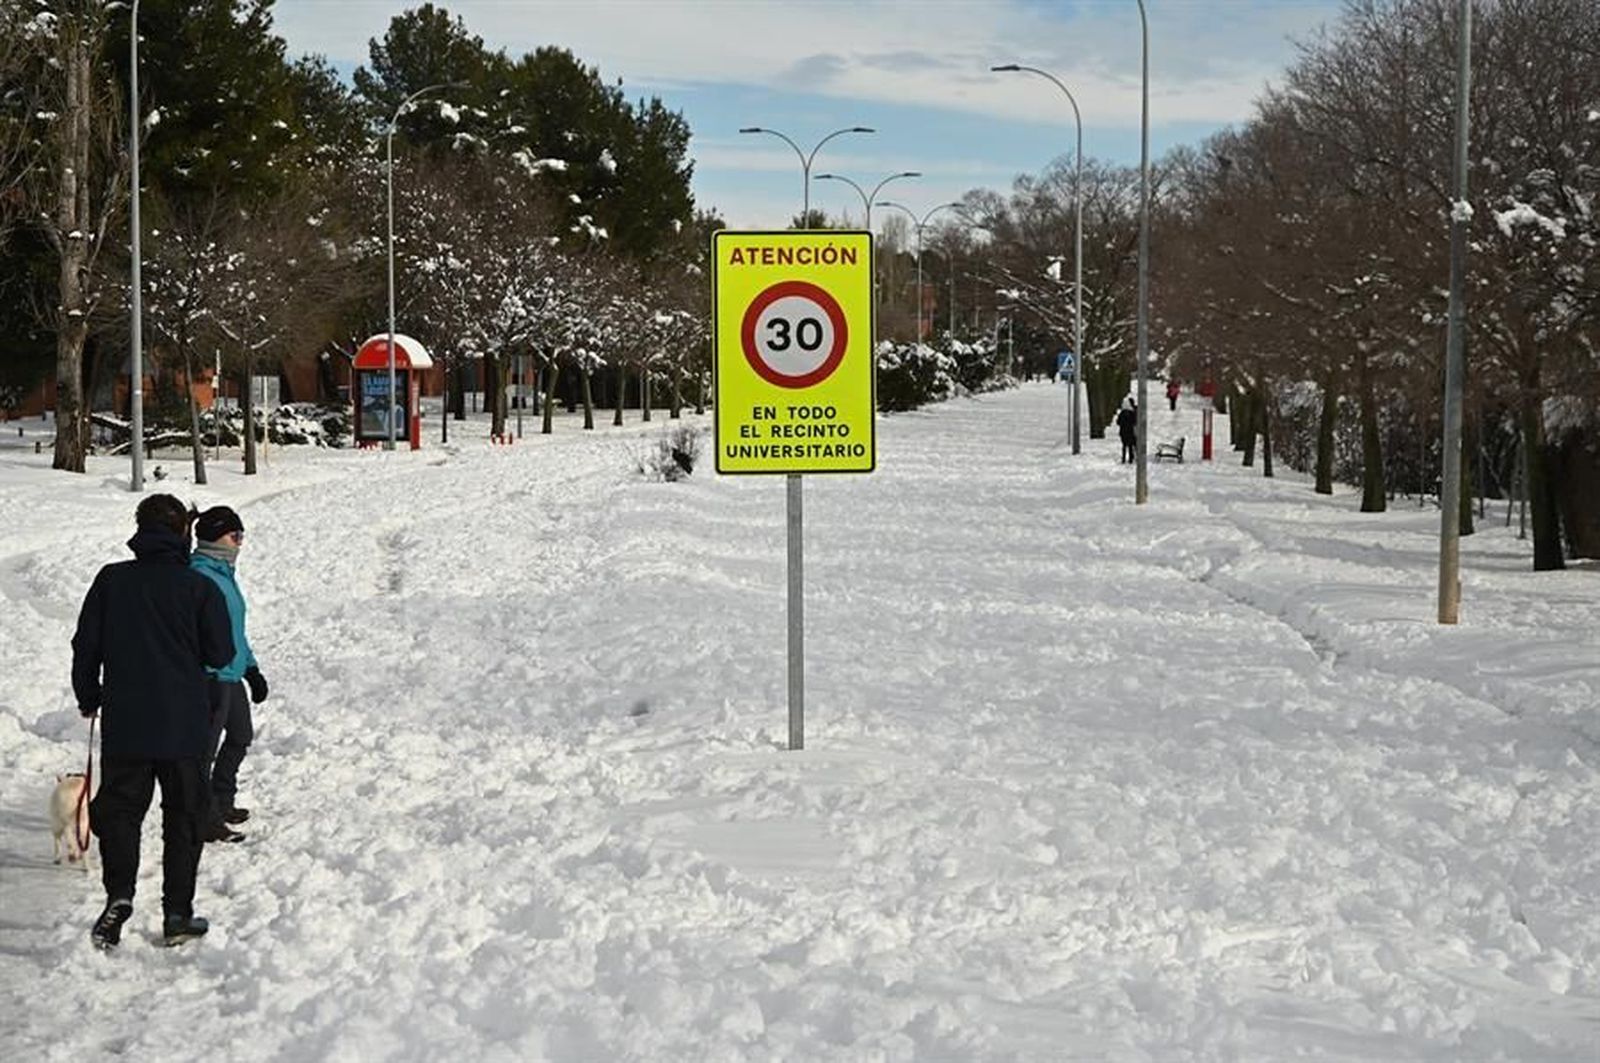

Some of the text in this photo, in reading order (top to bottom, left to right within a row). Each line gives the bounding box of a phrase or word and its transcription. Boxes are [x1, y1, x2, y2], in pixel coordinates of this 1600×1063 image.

[730, 243, 857, 265] ATENCIÓN
[766, 317, 824, 352] 30
[753, 406, 837, 420] EN TODO
[740, 424, 850, 438] EL RECINTO
[726, 443, 866, 458] UNIVERSITARIO
